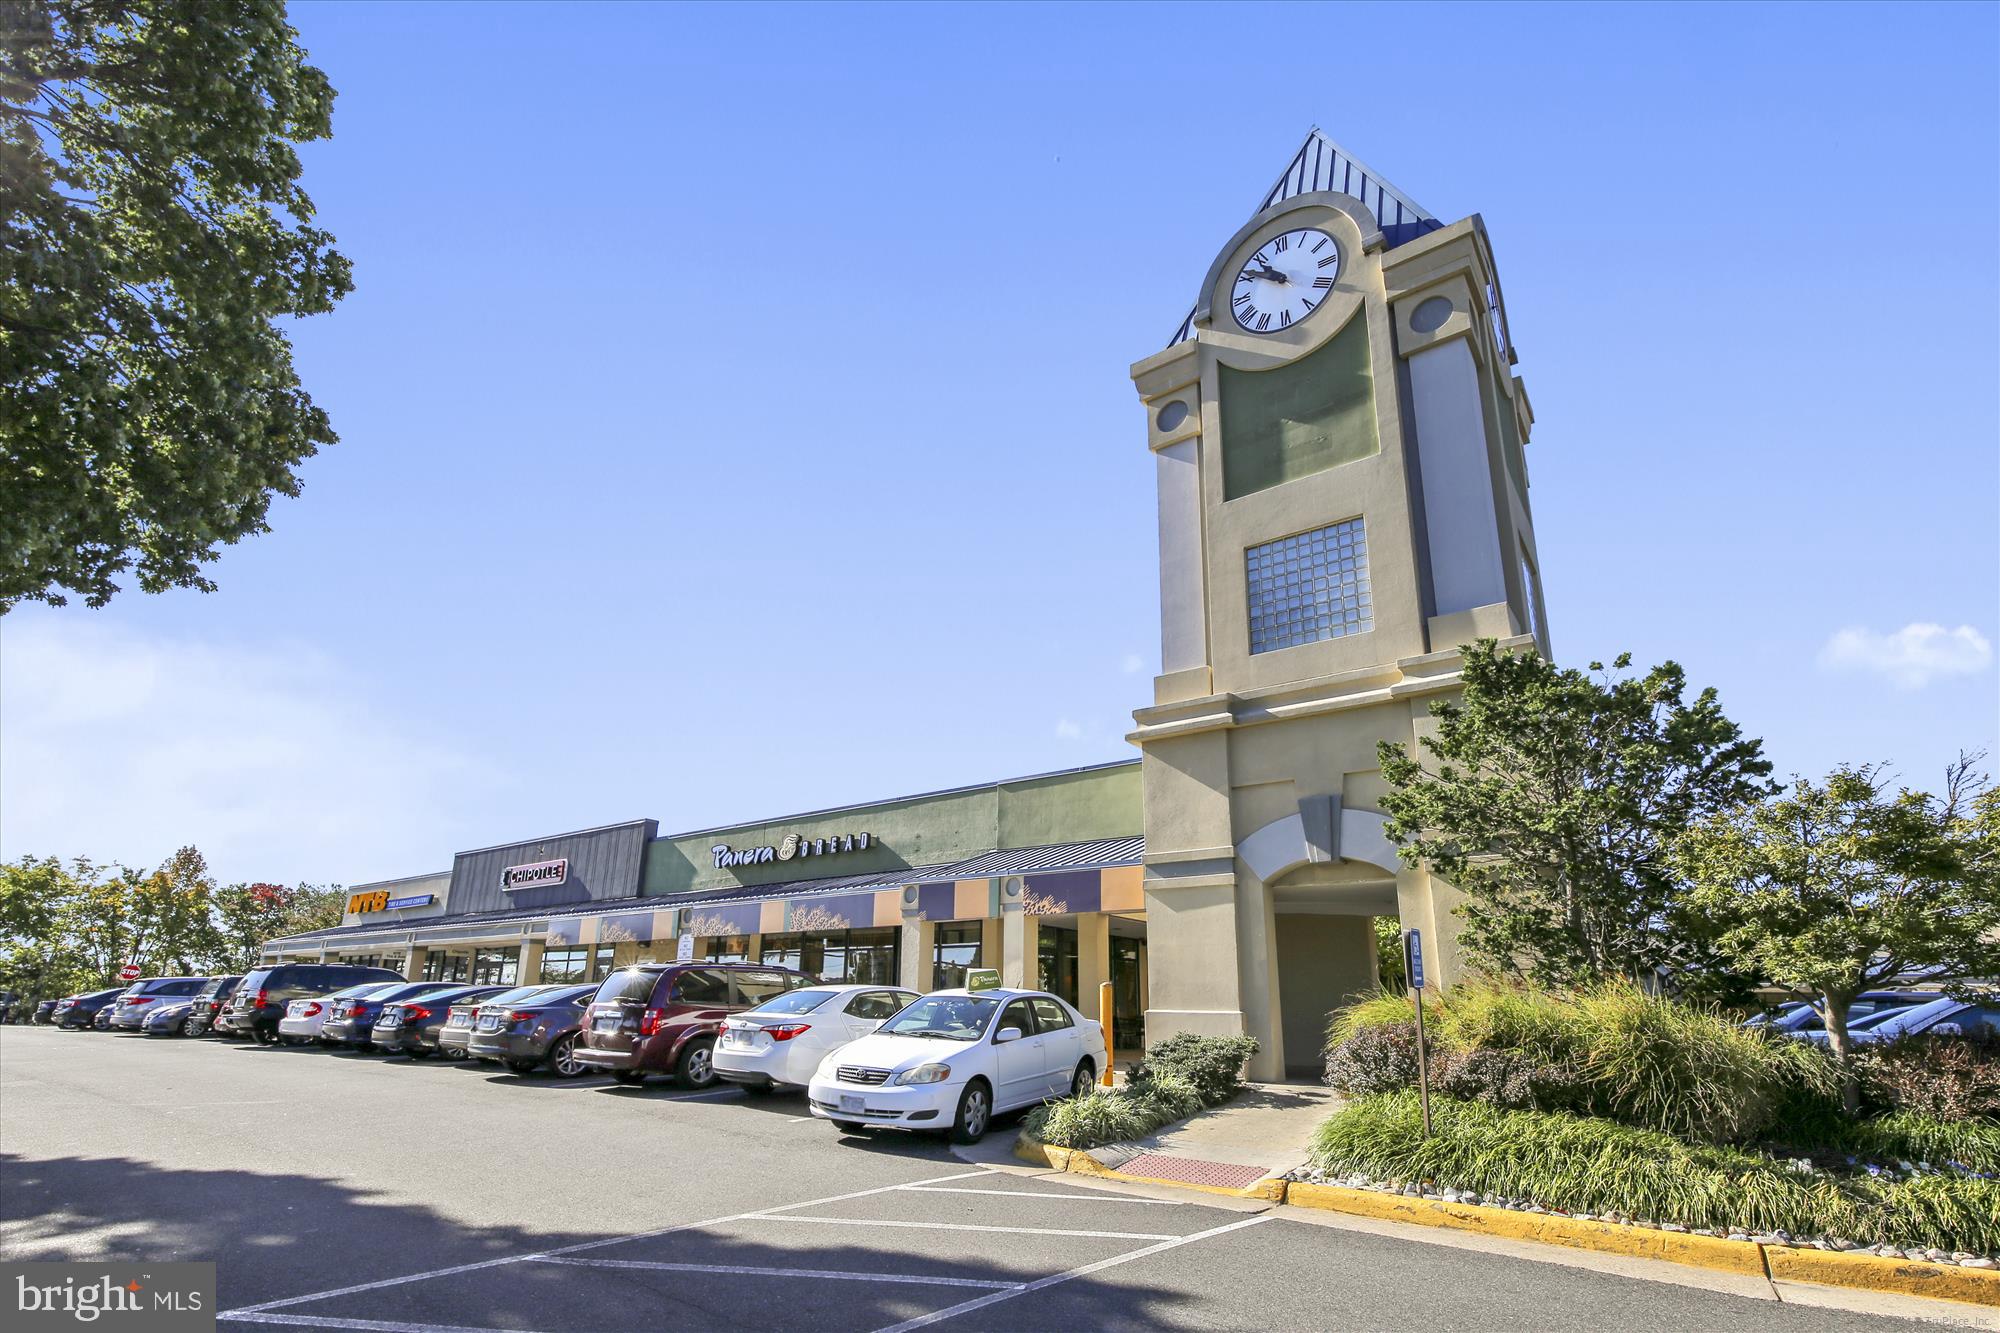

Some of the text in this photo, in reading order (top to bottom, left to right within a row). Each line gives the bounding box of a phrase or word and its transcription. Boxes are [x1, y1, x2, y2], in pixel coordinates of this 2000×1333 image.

[1274, 235, 1288, 255] XII
[711, 832, 869, 869] Panera BREAD
[510, 865, 559, 883] CHIPOTLE
[348, 890, 390, 914] NTB
